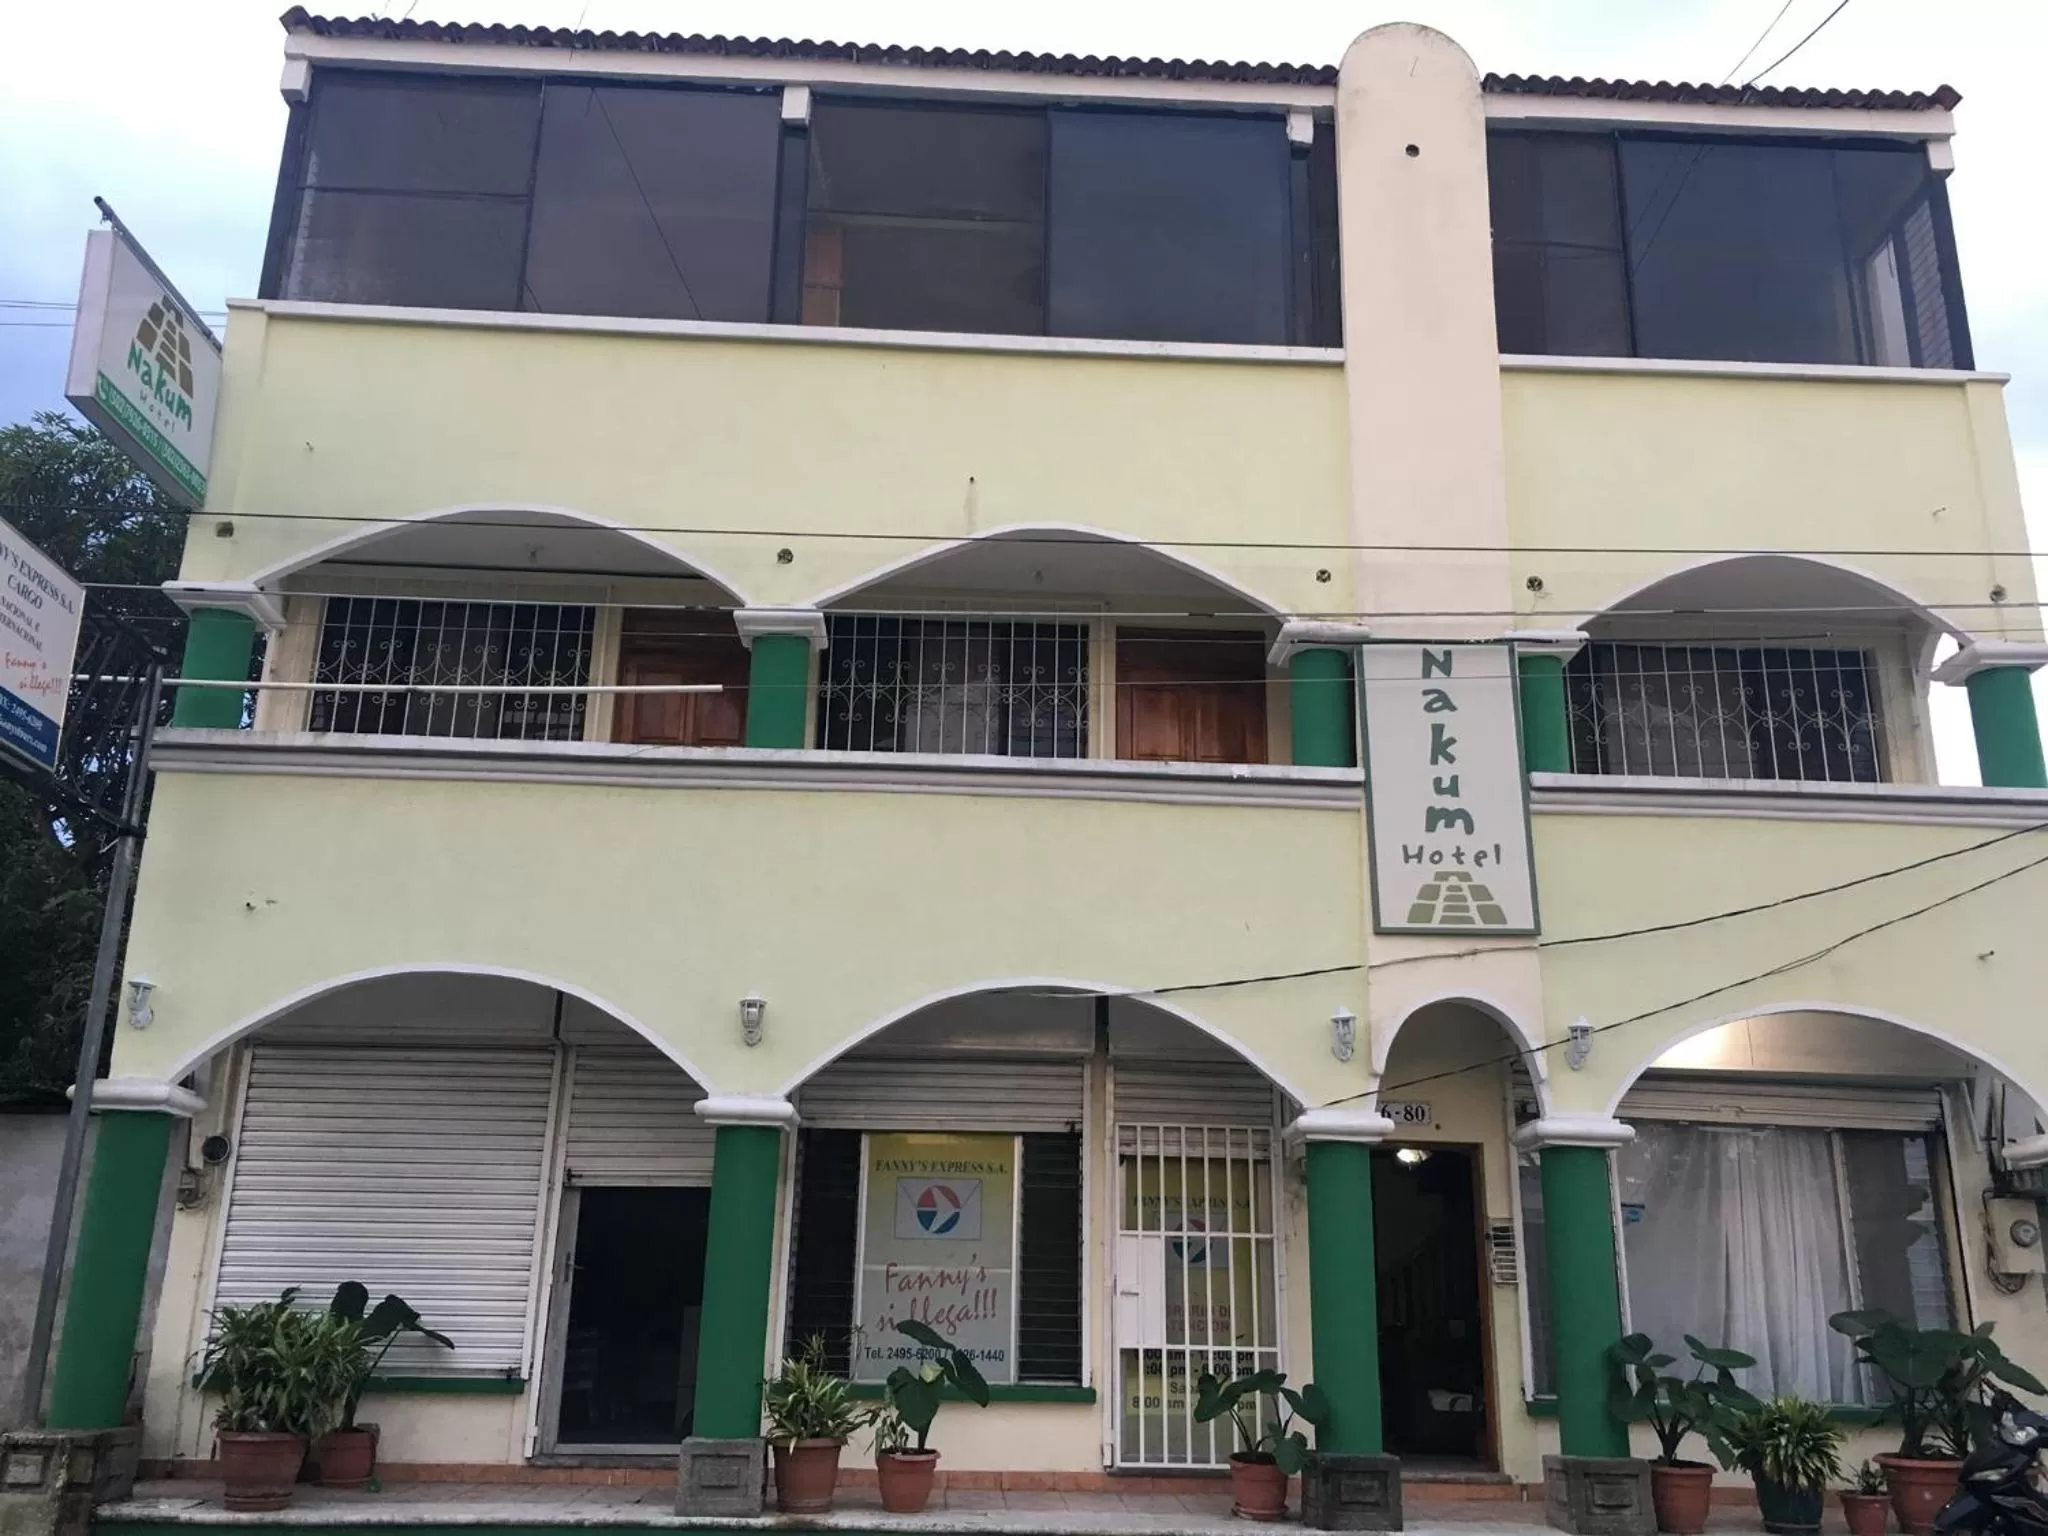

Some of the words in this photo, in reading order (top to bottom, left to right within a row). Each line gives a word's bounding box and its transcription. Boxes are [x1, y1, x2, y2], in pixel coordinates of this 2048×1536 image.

[127, 338, 192, 432] Nakum
[139, 388, 176, 433] Hotel
[7, 573, 43, 610] CARGO
[19, 559, 60, 602] EXPRESS
[1402, 843, 1501, 867] Hotel
[875, 1159, 928, 1173] FANNY'S
[930, 1160, 984, 1173] EXPRESS
[885, 1251, 987, 1296] Fanny's
[876, 1302, 898, 1332] si
[910, 1287, 998, 1336] llega!!!
[863, 1347, 884, 1359] Tel.
